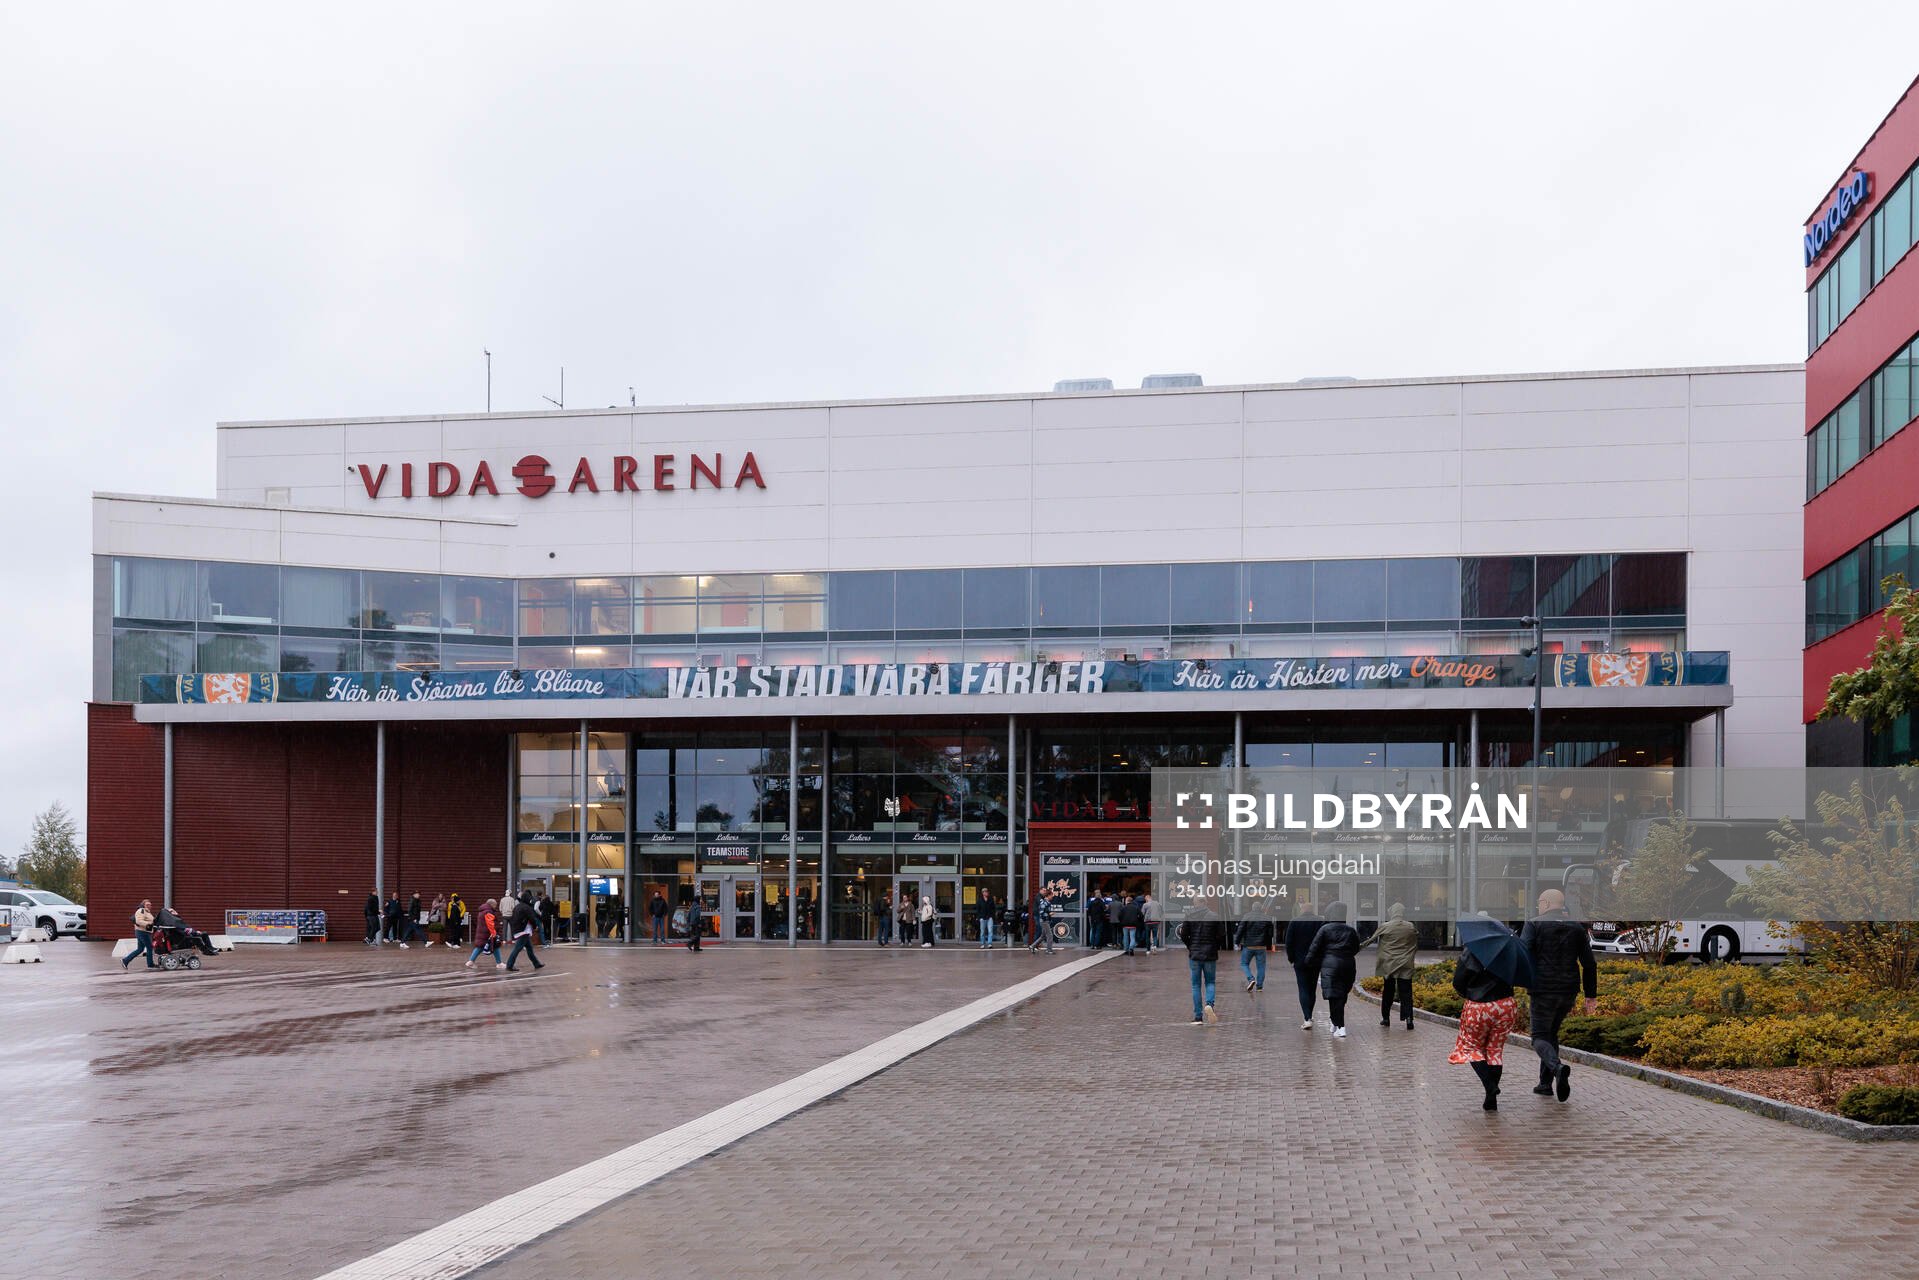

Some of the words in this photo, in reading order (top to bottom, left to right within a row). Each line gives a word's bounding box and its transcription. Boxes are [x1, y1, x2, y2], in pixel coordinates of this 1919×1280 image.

[803, 171, 869, 267] Nordea
[358, 460, 499, 498] VIDA
[568, 451, 766, 493] ARENA
[1173, 659, 1225, 689] Här
[1231, 668, 1259, 689] är
[1266, 659, 1350, 687] Hösten
[1355, 662, 1402, 681] mer
[1411, 656, 1496, 687] Orange
[668, 666, 738, 698] VÅR
[747, 665, 843, 697] STAD
[855, 663, 949, 696] VÅRA
[960, 661, 1105, 695] FÄRGER
[326, 676, 370, 701] Här
[375, 684, 400, 701] är
[406, 676, 487, 701] Sjöarna
[493, 671, 525, 694] lite
[531, 669, 604, 695] Blåare
[1033, 801, 1096, 818] VIDA
[532, 833, 555, 841] Lakers
[589, 833, 612, 841] Lakers
[715, 833, 739, 841] Lakers
[780, 834, 804, 842] Lars
[847, 833, 871, 842] Lakers
[912, 833, 937, 841] Lakers
[982, 833, 1007, 841] Lakers
[707, 847, 749, 856] TEAMSTORE
